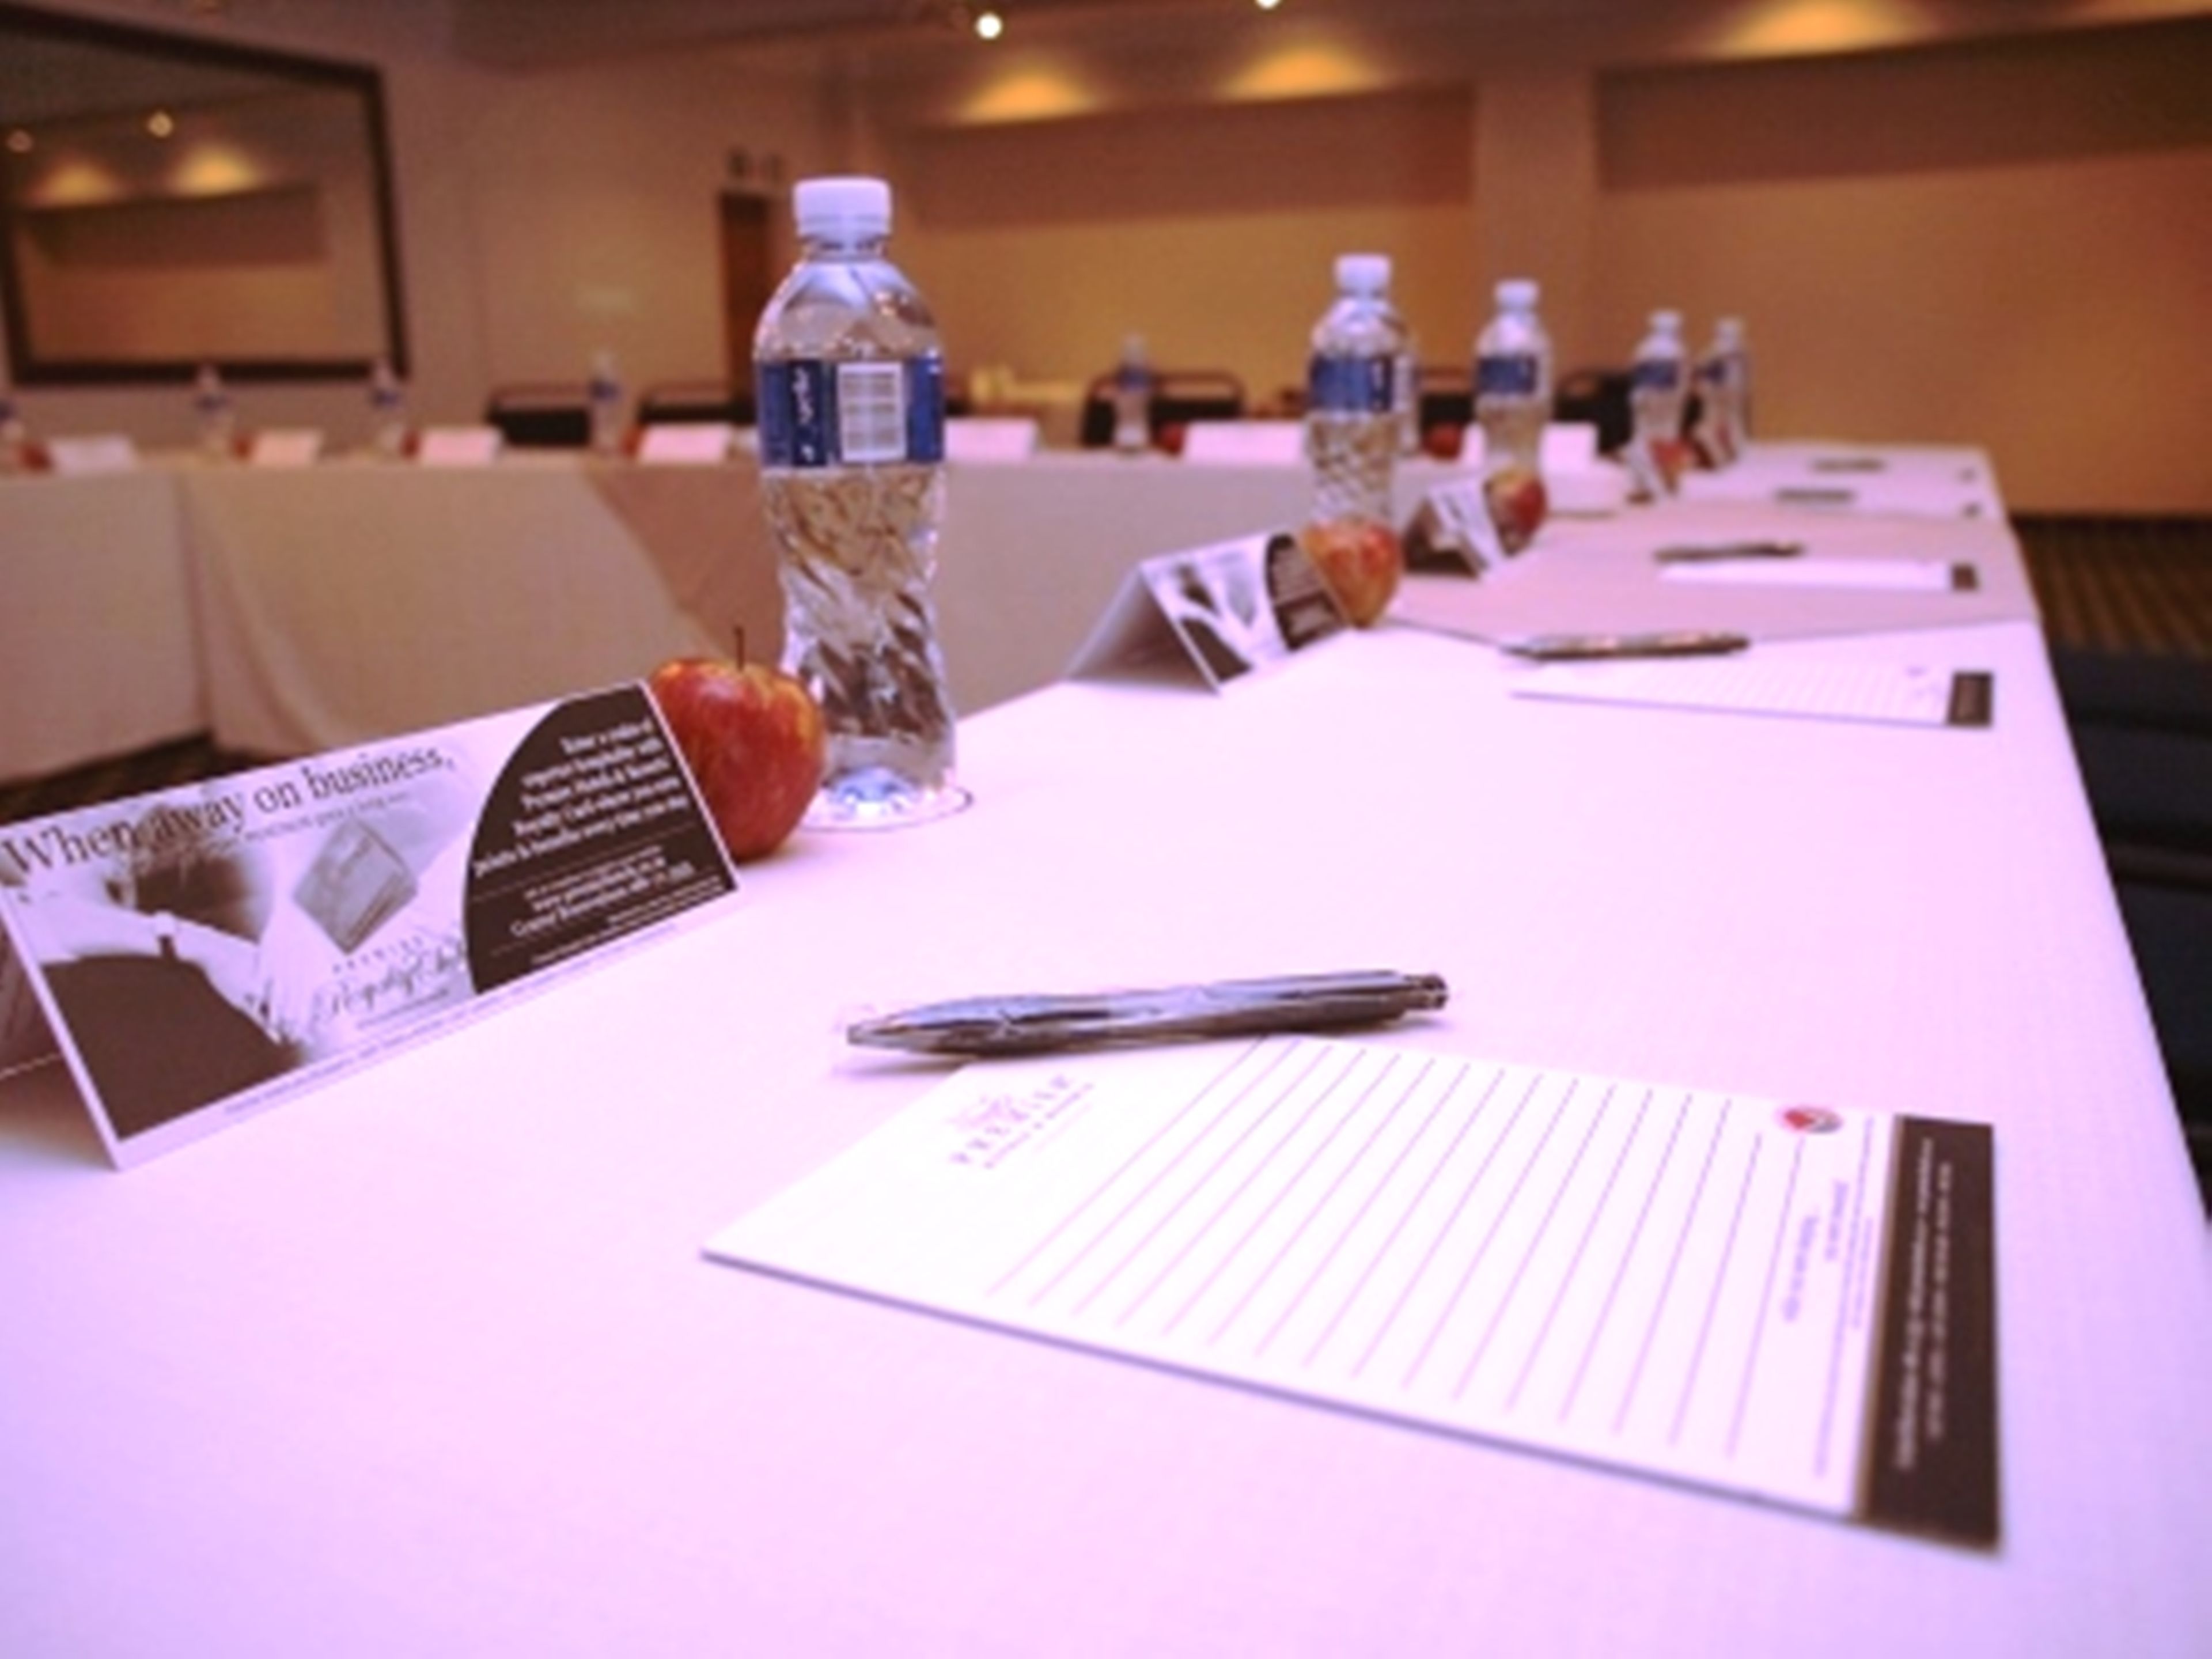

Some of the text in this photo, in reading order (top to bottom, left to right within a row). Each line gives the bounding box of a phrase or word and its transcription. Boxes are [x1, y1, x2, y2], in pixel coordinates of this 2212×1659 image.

[2, 819, 142, 873] When
[153, 790, 245, 843] away
[253, 780, 302, 813] on
[302, 747, 456, 798] business,
